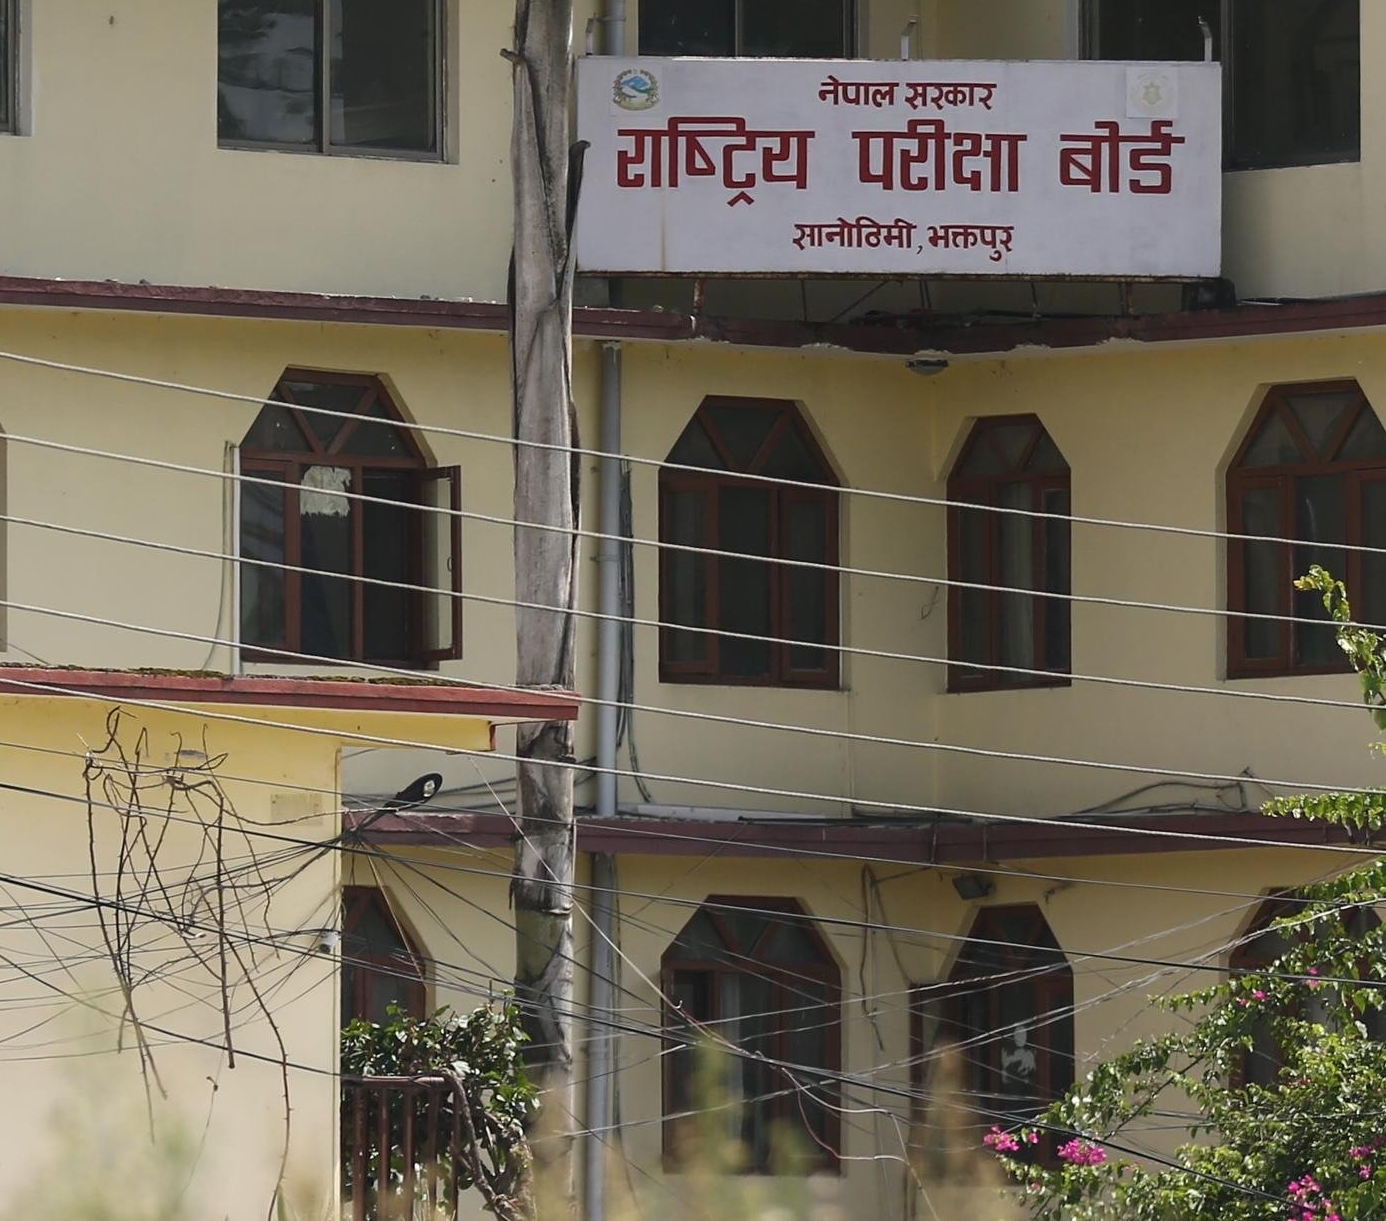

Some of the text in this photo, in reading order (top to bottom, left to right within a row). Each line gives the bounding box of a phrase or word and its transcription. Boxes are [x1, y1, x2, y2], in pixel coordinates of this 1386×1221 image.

[818, 75, 997, 111] नेपाल सरकार
[616, 116, 1185, 206] राष्ट्रिय परीक्षा बोर्ड
